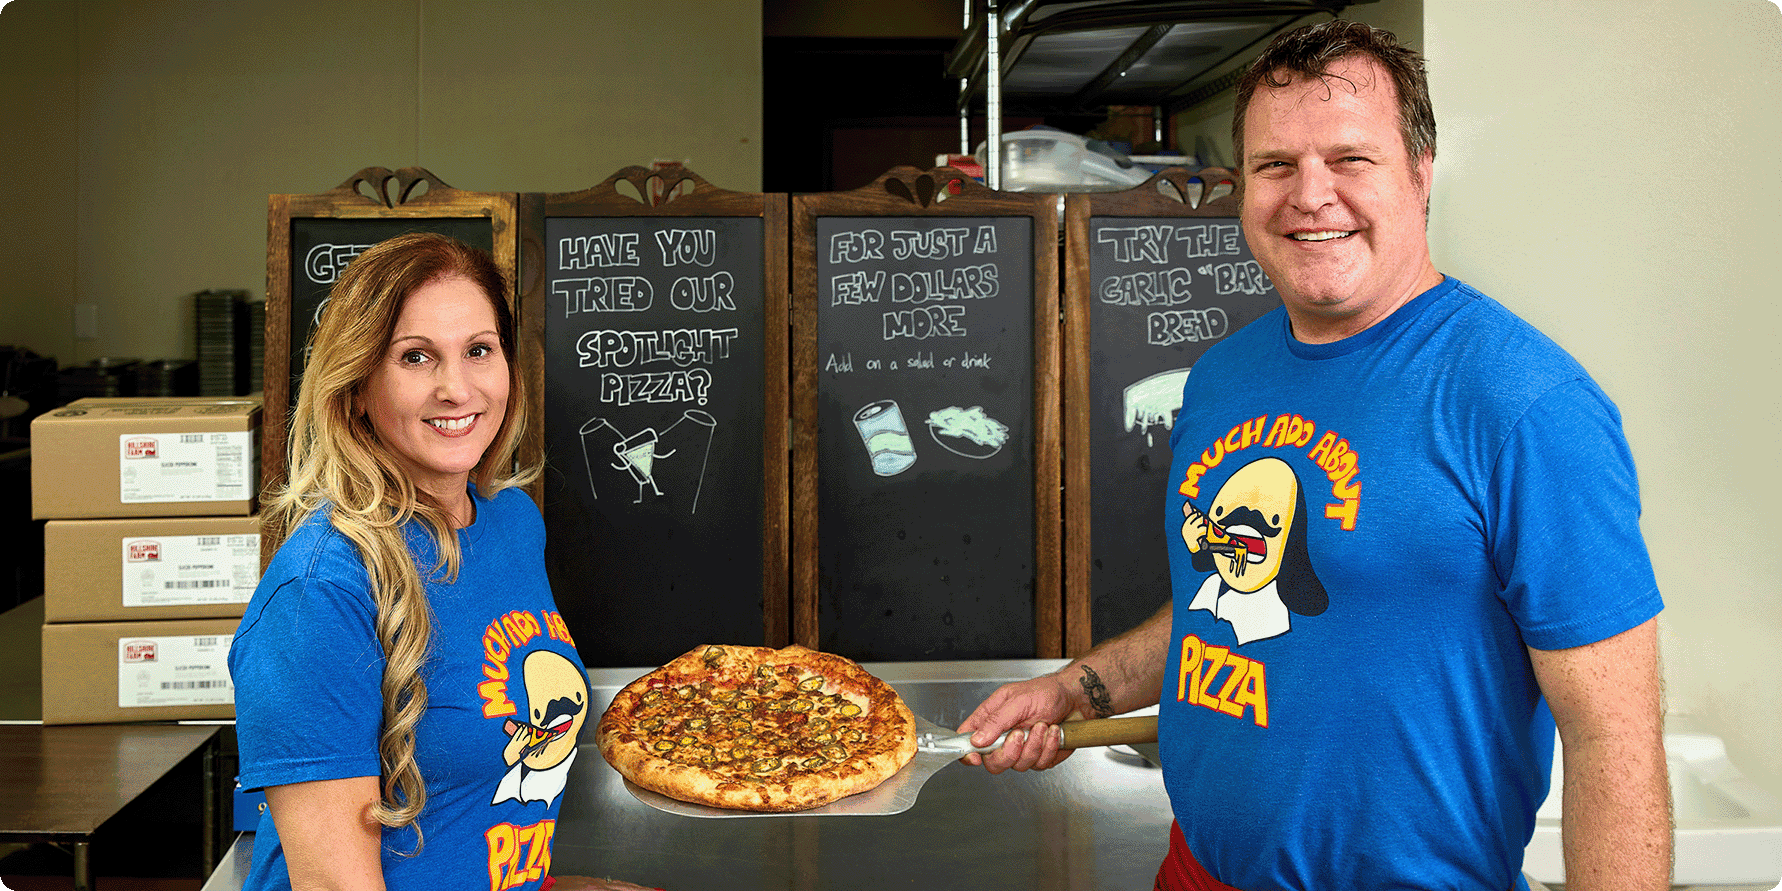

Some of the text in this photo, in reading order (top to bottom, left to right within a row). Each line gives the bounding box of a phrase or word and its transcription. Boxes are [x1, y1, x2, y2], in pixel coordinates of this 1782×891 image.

[305, 243, 376, 283] GE
[559, 229, 716, 270] HAVE YOU
[830, 225, 997, 264] FOR JUST A
[1097, 224, 1241, 264] TRY THE
[552, 271, 736, 318] TRIED OUR
[831, 263, 1000, 307] FEW DOLLARS
[1100, 267, 1192, 306] GARLIC
[883, 304, 967, 341] MORE
[1147, 307, 1229, 346] BREAD
[576, 328, 738, 368] SPOTLIGHT
[825, 351, 992, 373] Add on a salad or drink
[600, 368, 712, 406] PIZZA?
[1178, 413, 1362, 532] MUCH ADO ABOUT
[477, 610, 576, 719] MUCH ADO AB
[1176, 633, 1269, 729] PIZZA
